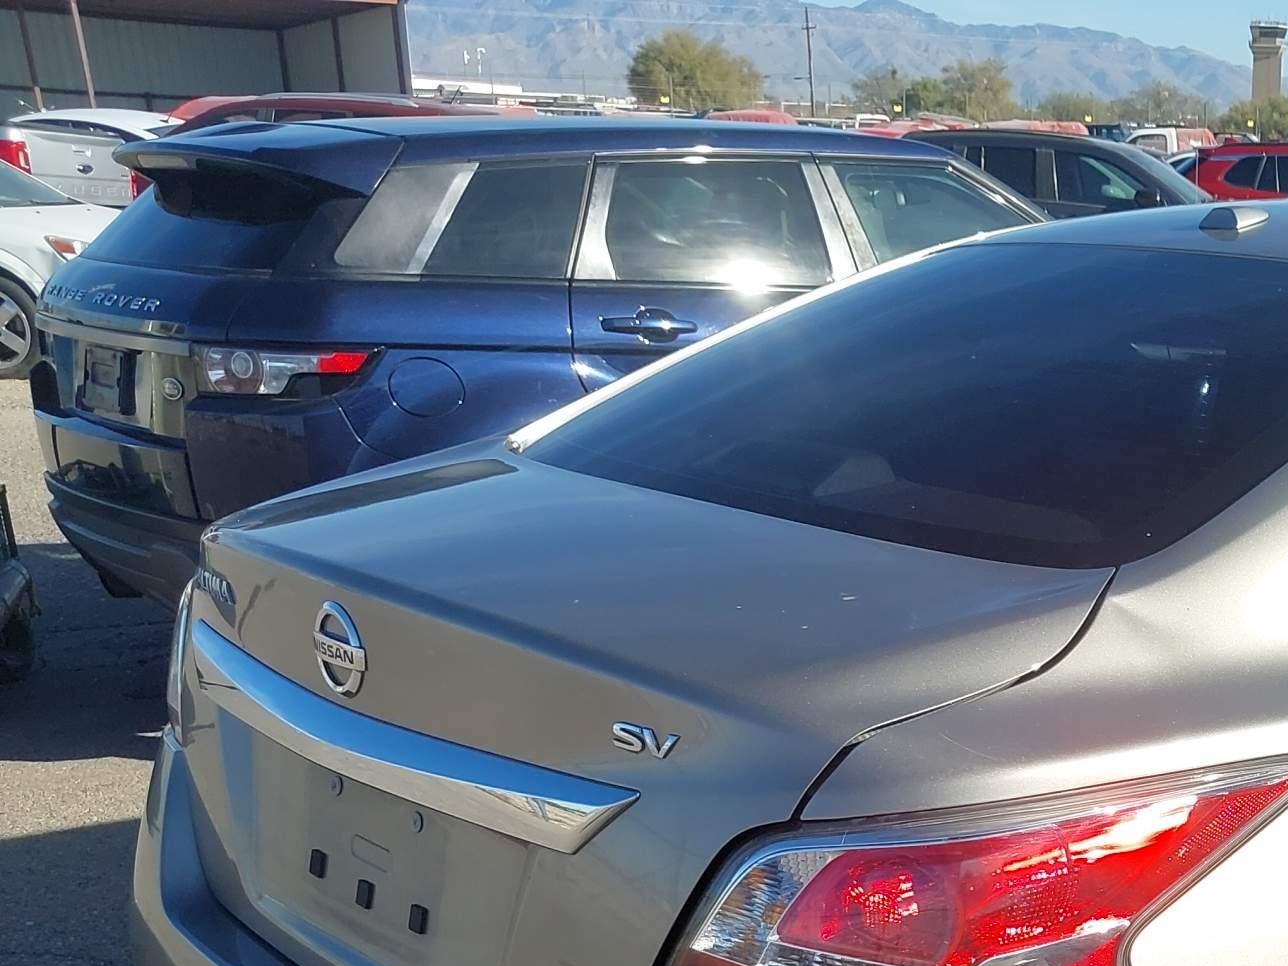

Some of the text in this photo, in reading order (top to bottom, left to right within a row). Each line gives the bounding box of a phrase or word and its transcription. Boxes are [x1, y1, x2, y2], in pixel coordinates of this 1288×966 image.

[47, 284, 160, 313] RANGE ROVER
[314, 634, 355, 666] NISSAN
[611, 720, 682, 760] SV
